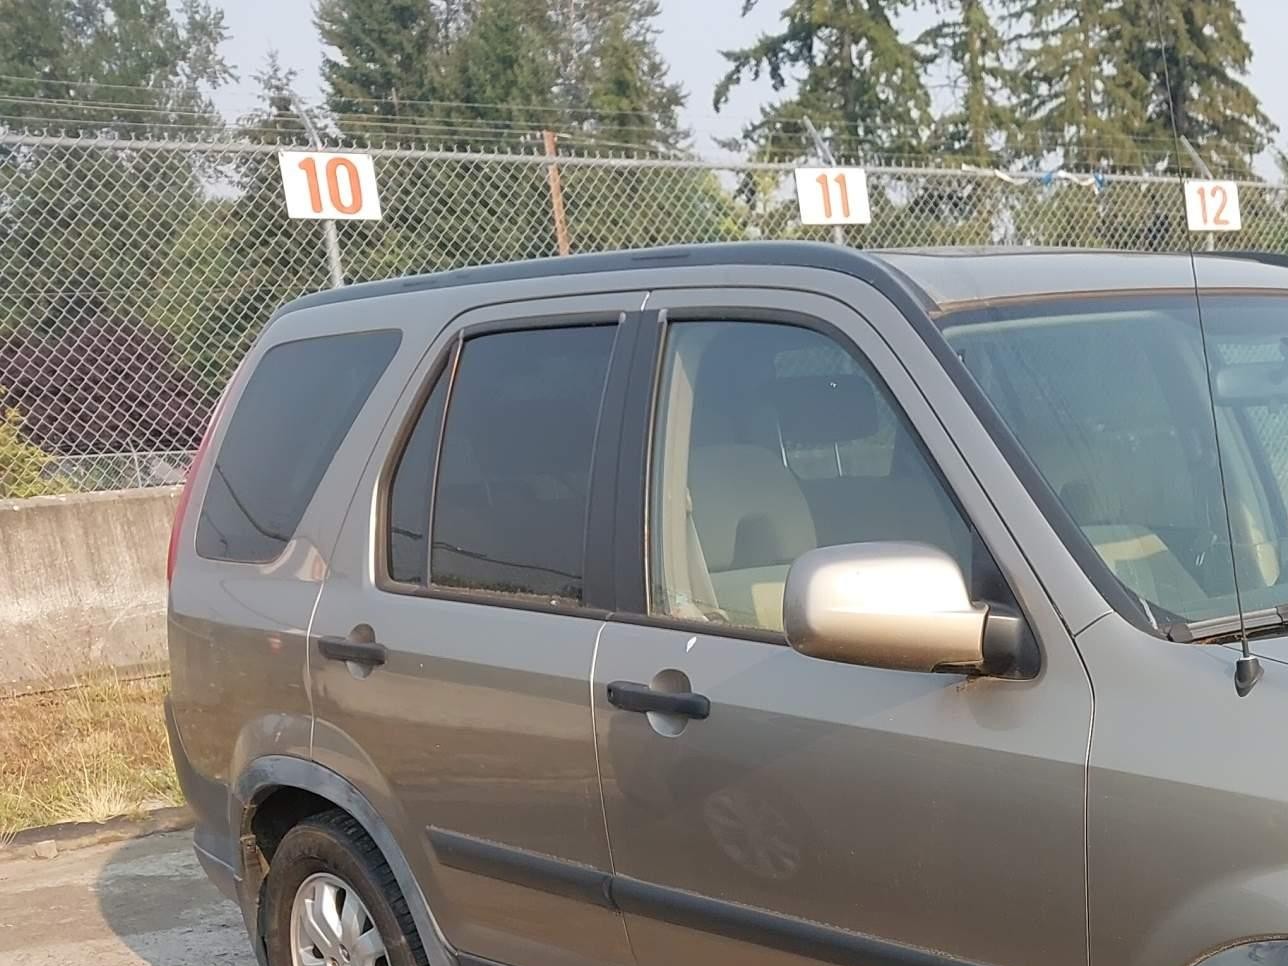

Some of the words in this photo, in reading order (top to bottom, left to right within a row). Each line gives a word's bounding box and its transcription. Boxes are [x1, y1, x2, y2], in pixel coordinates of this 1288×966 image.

[298, 157, 363, 215] 10
[816, 173, 850, 218] 11
[1196, 185, 1230, 225] 12
